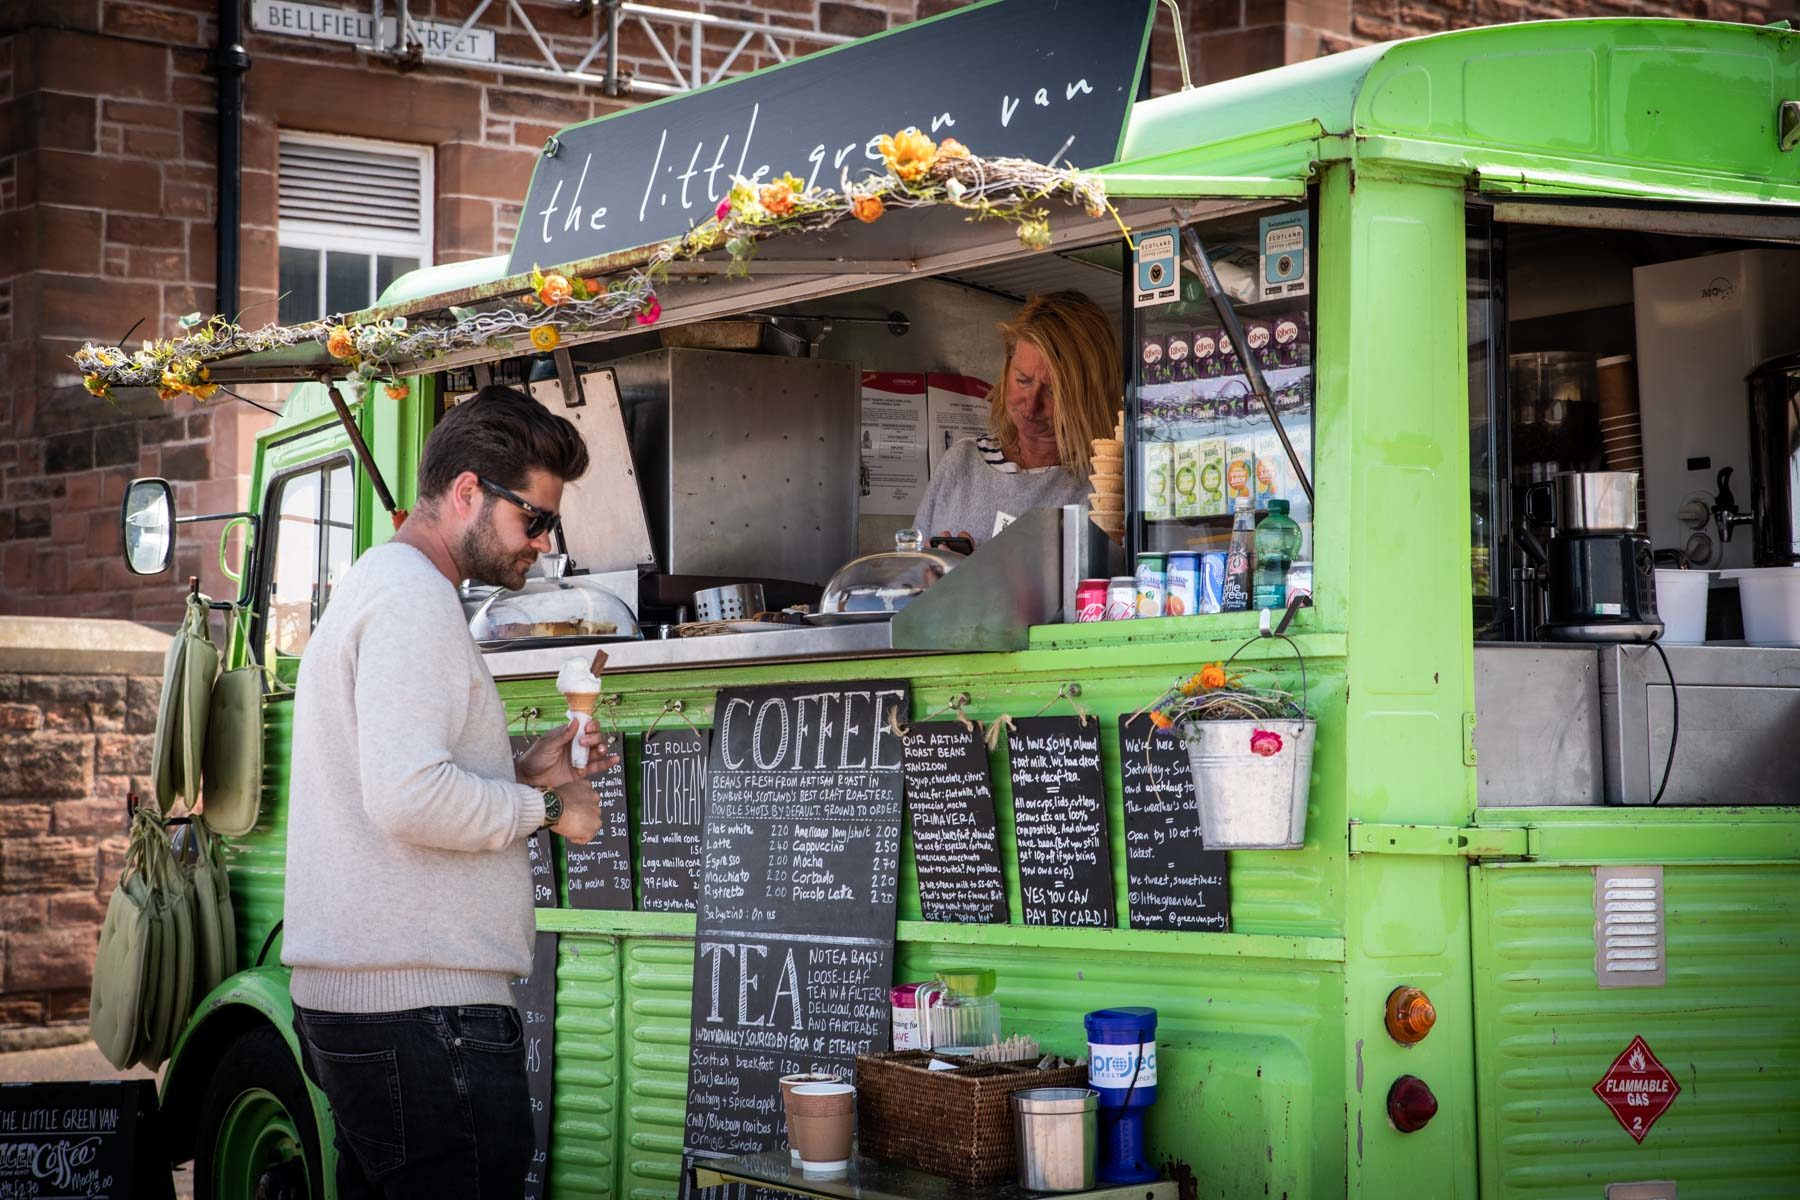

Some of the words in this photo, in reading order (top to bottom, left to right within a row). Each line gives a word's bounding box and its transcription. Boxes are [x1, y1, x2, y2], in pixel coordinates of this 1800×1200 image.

[539, 154, 607, 242] the
[805, 111, 956, 192] gren
[1001, 78, 1093, 127] van
[1269, 232, 1300, 241] SCOTLAND
[1141, 241, 1171, 250] SCOTLAND
[1249, 333, 1269, 343] Ribena
[1277, 328, 1297, 338] Ribena
[1144, 350, 1162, 358] Ribena
[1169, 346, 1188, 355] Ribena
[1195, 342, 1215, 353] Ribena
[722, 690, 904, 770] COFFEE
[903, 735, 926, 746] OUR
[930, 733, 972, 745] ARTISAN
[1010, 736, 1024, 751] We
[1027, 736, 1045, 749] have
[1156, 738, 1174, 751] here
[646, 743, 660, 755] DI
[665, 742, 701, 754] ROLLO
[905, 748, 934, 757] ROAST
[938, 747, 966, 757] BEANS
[905, 762, 947, 772] JANSZOON
[712, 776, 741, 788] BEANS
[745, 776, 773, 787] FRESH
[776, 777, 797, 788] FROM
[800, 776, 833, 787] ARTISAN
[838, 775, 865, 787] ROAST
[1013, 769, 1034, 786] coffee
[641, 760, 662, 824] ICE
[666, 755, 707, 825] CREAM
[1125, 782, 1141, 793] and
[800, 791, 817, 802] BEST
[820, 790, 844, 802] CRAFT
[712, 805, 742, 816] DOUBLE
[745, 805, 768, 816] SHOTS
[772, 805, 784, 818] BY
[825, 804, 854, 815] GROUND
[857, 805, 866, 815] TO
[914, 812, 976, 826] PRIMAVERA
[707, 824, 726, 834] Flat
[795, 826, 828, 838] Americano
[876, 826, 897, 837] 2.00
[1127, 831, 1149, 844] Open
[1154, 829, 1164, 844] by
[1169, 828, 1178, 838] 10
[1180, 827, 1190, 838] at
[662, 833, 681, 843] vanilla
[684, 835, 700, 843] cone
[1084, 836, 1099, 848] still
[706, 840, 731, 849] Latte
[793, 842, 844, 854] Cappuccino
[875, 843, 897, 853] 2.50
[1130, 847, 1155, 858] latest.
[568, 851, 596, 864] Hazelnut
[662, 858, 684, 867] vanilla
[685, 859, 700, 867] cone
[706, 855, 740, 869] Espresso
[769, 855, 787, 866] 2.00
[793, 856, 823, 868] Mocha
[1076, 850, 1096, 864] bring
[569, 864, 588, 873] mocha
[585, 878, 605, 888] mocha
[656, 877, 679, 888] flake
[705, 870, 749, 883] Macchiato
[792, 871, 834, 884] Cortado
[1130, 875, 1142, 885] We
[535, 885, 552, 900] 50p
[705, 885, 744, 898] Ristretto
[793, 888, 824, 901] Piccolo
[1024, 886, 1045, 905] YES,
[1047, 889, 1065, 903] YOU
[1068, 889, 1088, 904] CAN
[664, 899, 684, 909] gluten
[1026, 908, 1046, 925] PAY
[1052, 909, 1067, 925] BY
[808, 969, 870, 984] LOOSE-LEAF
[701, 942, 803, 1030] TEA
[807, 986, 826, 999] TEA
[808, 1017, 826, 1031] AND
[777, 1032, 788, 1050] BY
[814, 1037, 825, 1054] OF
[692, 1049, 729, 1066] Scottish
[737, 1055, 774, 1071] breakfast
[781, 1059, 799, 1073] 1.30
[694, 1069, 739, 1094] Darjeeling
[1606, 1080, 1668, 1092] FLAMMABLE
[1628, 1094, 1649, 1106] GAS
[22, 1109, 59, 1130] LITTLE
[63, 1109, 95, 1130] GREEN
[1633, 1117, 1642, 1129] 2
[32, 1136, 102, 1189] Coffee
[72, 1169, 99, 1192] Mocha
